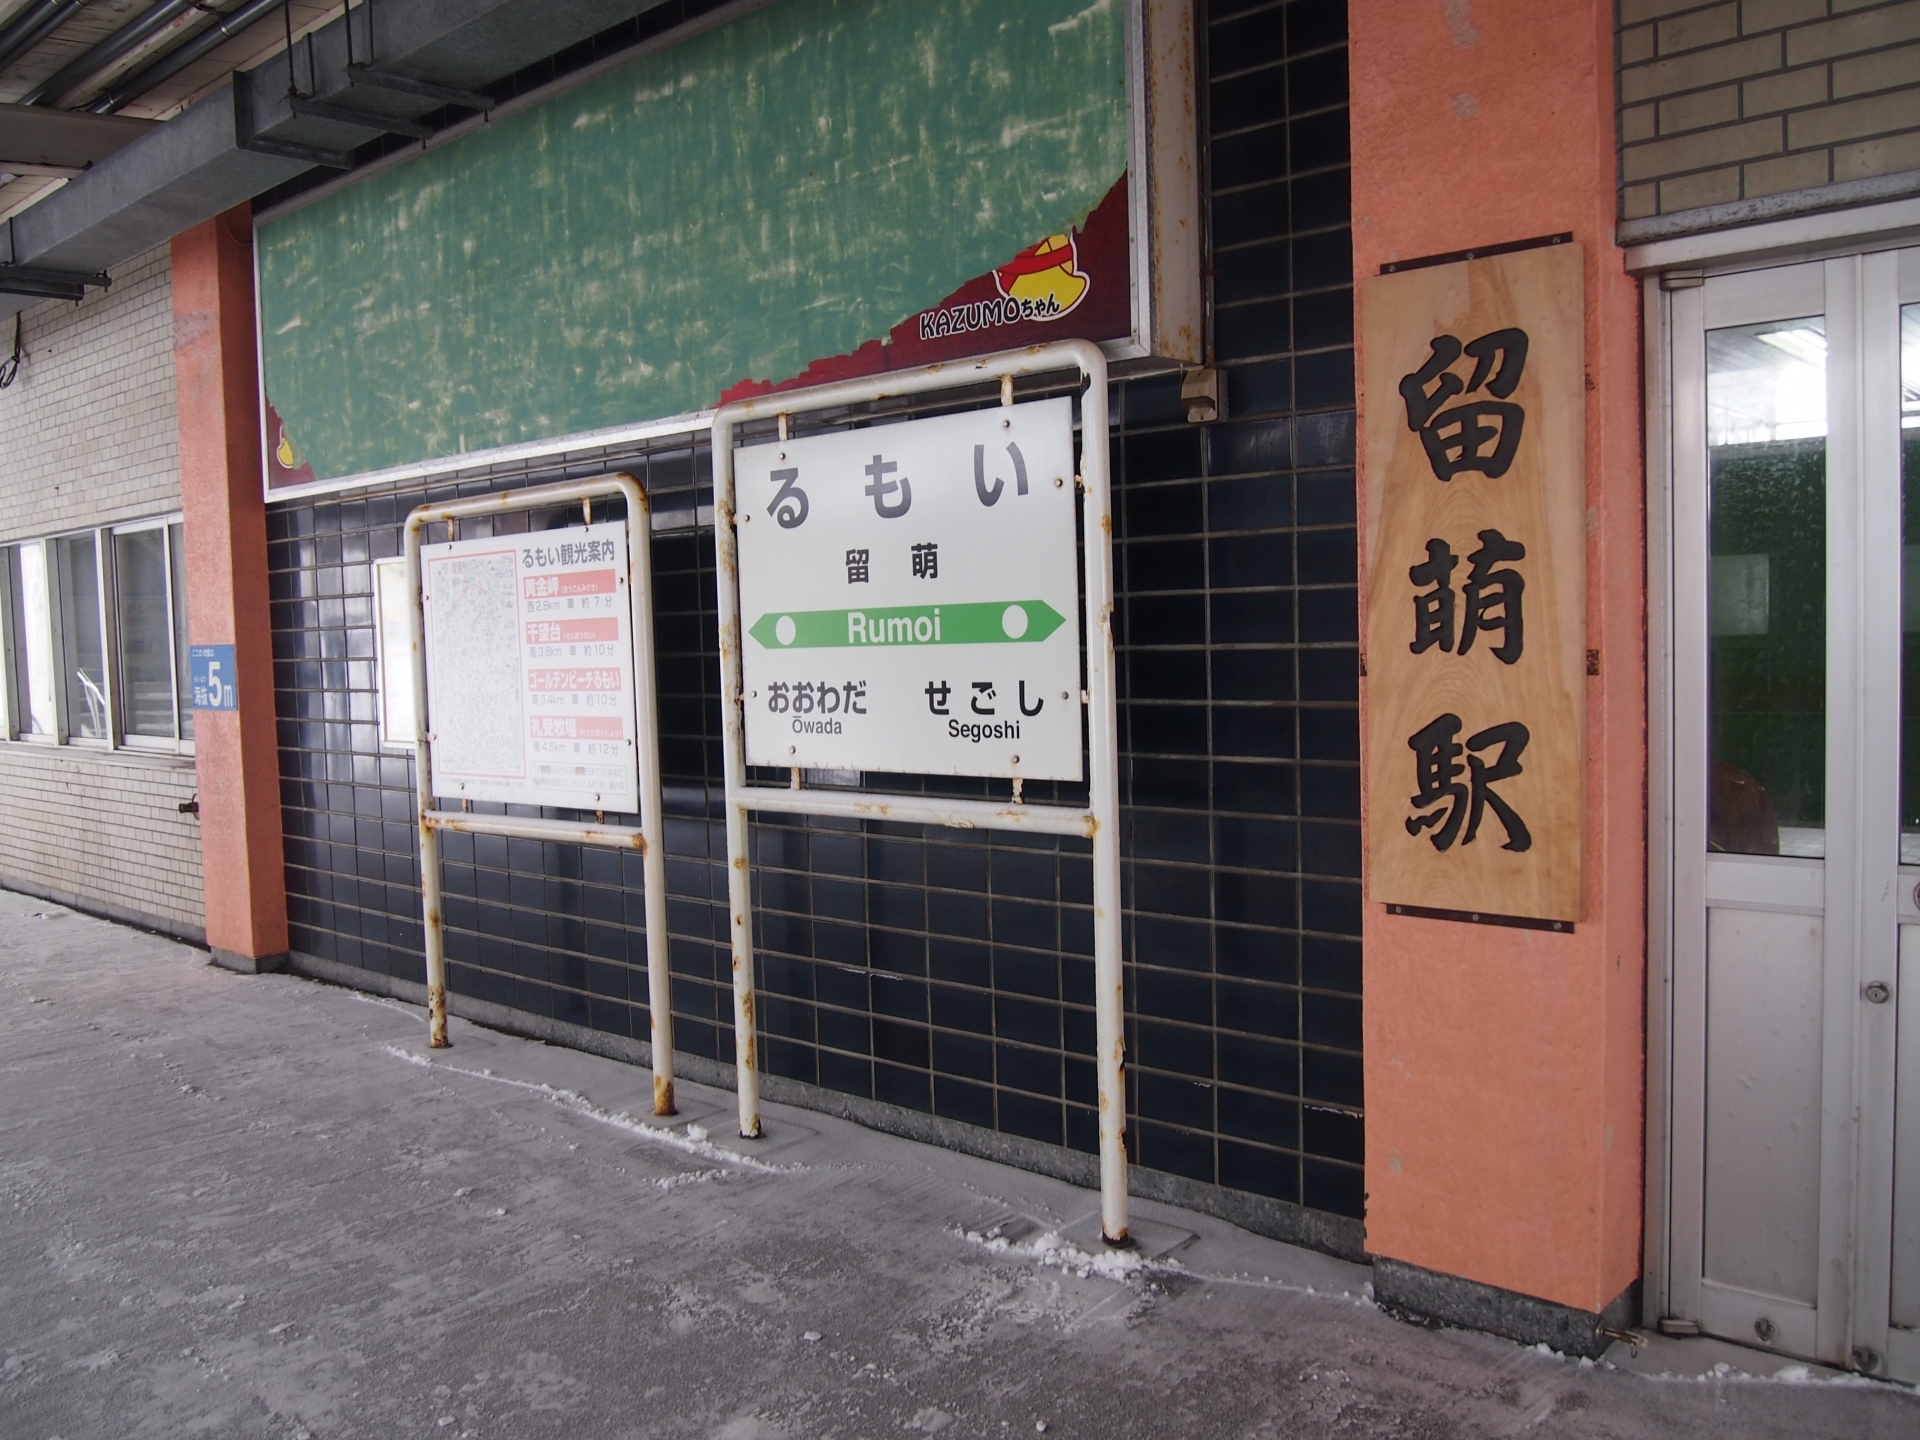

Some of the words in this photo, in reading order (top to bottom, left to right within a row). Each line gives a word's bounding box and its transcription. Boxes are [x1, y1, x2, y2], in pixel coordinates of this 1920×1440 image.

[920, 292, 1060, 340] KAZUMOちゃん
[767, 441, 1029, 529] るもい
[522, 539, 615, 568] るもい観光案内
[845, 542, 938, 584] 留萌
[525, 576, 559, 598] 黄金岬
[1400, 327, 1532, 852] 留萌駅
[527, 622, 561, 642] 千望台
[848, 608, 941, 643] Rumoi
[530, 670, 619, 689] ゴールデンビーチるもい
[768, 680, 867, 715] おおわだ
[924, 680, 1044, 716] せごし
[531, 717, 577, 737] 礼受牧場
[792, 716, 842, 735] Ōwada
[948, 719, 1020, 743] Segoshi
